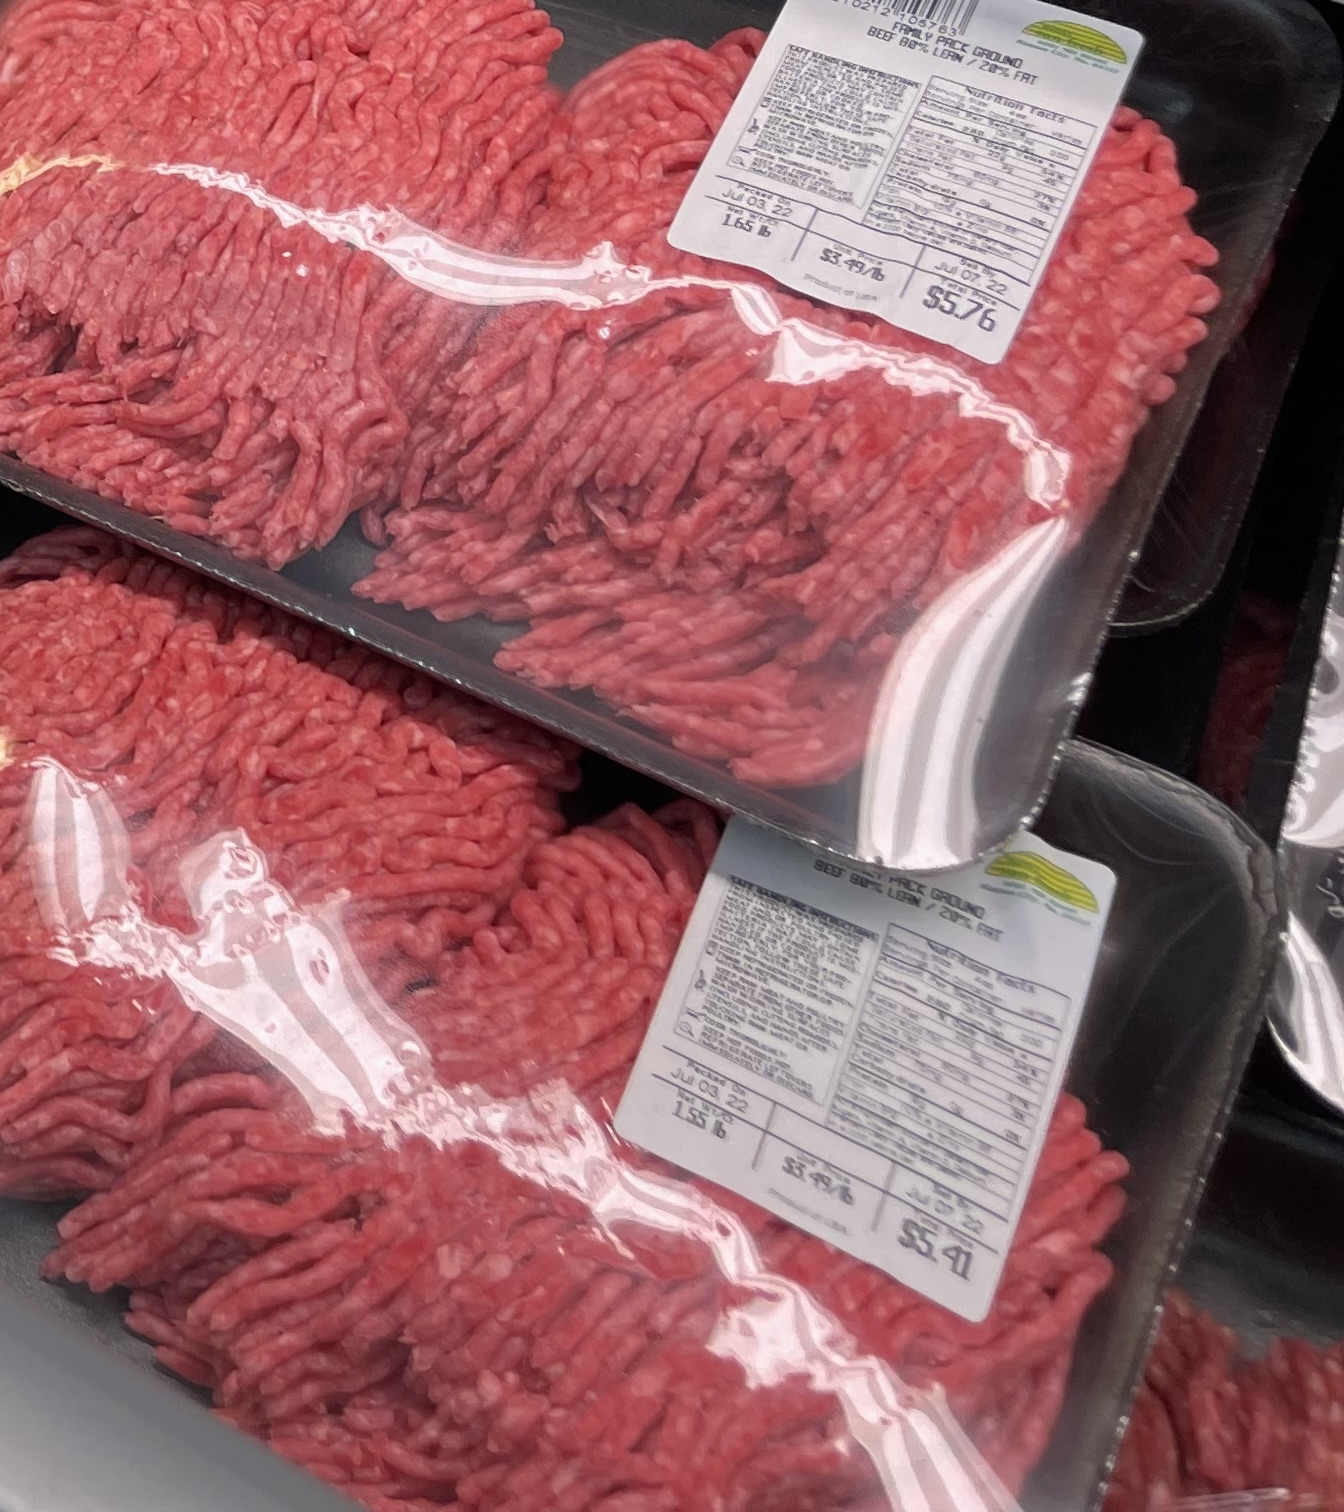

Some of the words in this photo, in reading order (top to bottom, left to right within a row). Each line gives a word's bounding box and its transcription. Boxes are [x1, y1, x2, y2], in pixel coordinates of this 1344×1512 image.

[866, 26, 894, 43] BEEF
[898, 34, 929, 55] 80%
[932, 46, 964, 64] LEAN
[977, 59, 1011, 78] 20%
[1012, 68, 1039, 86] FAT
[892, 21, 935, 43] FAMILY
[934, 35, 969, 54] PACK
[971, 44, 1024, 69] GROUND
[965, 86, 1025, 112] Nutrition
[1027, 103, 1065, 125] Facts
[721, 188, 744, 203] Jul
[771, 204, 794, 218] 22
[737, 182, 775, 201] Packed
[720, 212, 754, 233] 1.65
[803, 272, 840, 291] Product
[819, 247, 886, 283] $3.49/lb
[934, 260, 958, 276] Jul
[985, 280, 1009, 295] 22
[921, 284, 998, 333] $5.76
[814, 859, 846, 878] BEEF
[887, 888, 922, 907] LEAN
[976, 922, 1004, 942] FAT
[930, 888, 986, 919] GROUND
[669, 1068, 695, 1086] Jul
[727, 1095, 751, 1114] 22
[671, 1101, 707, 1129] 1.55
[782, 1156, 855, 1206] $3.49/lb
[896, 1218, 975, 1282] $5.41
